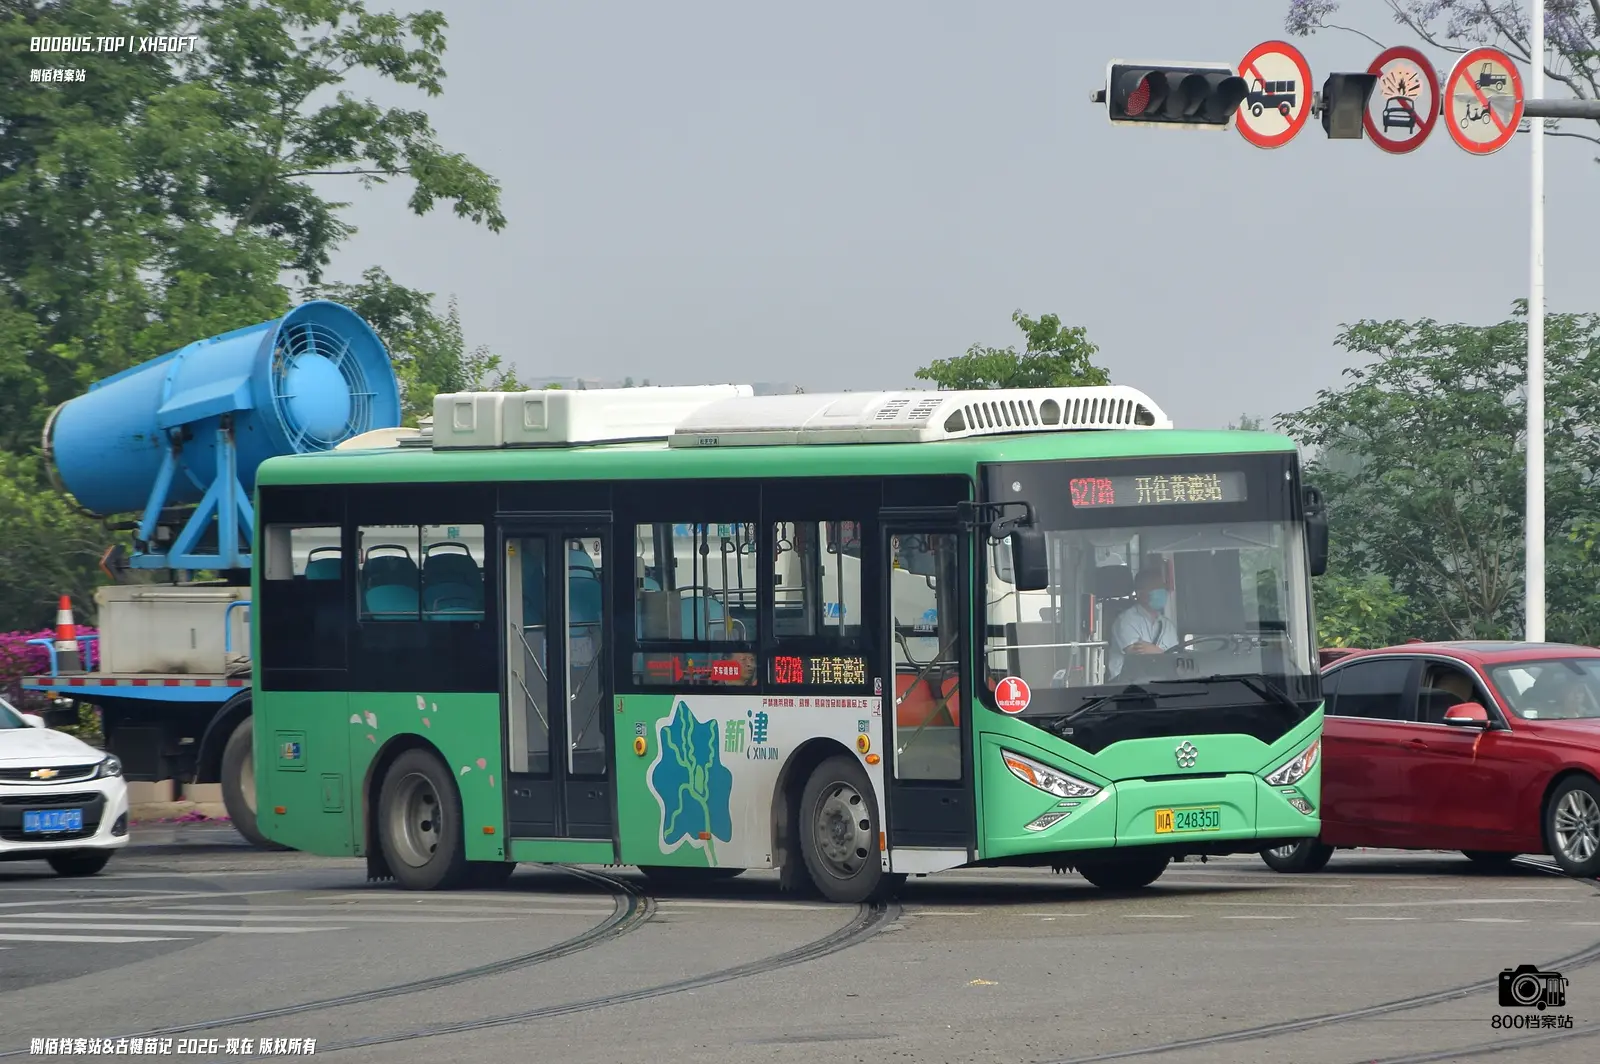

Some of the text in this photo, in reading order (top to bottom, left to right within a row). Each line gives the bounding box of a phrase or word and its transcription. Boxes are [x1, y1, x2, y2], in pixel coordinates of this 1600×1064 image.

[1069, 474, 1223, 505] 527路 开往黄渡站
[775, 656, 865, 685] 527路 开往黄渡站
